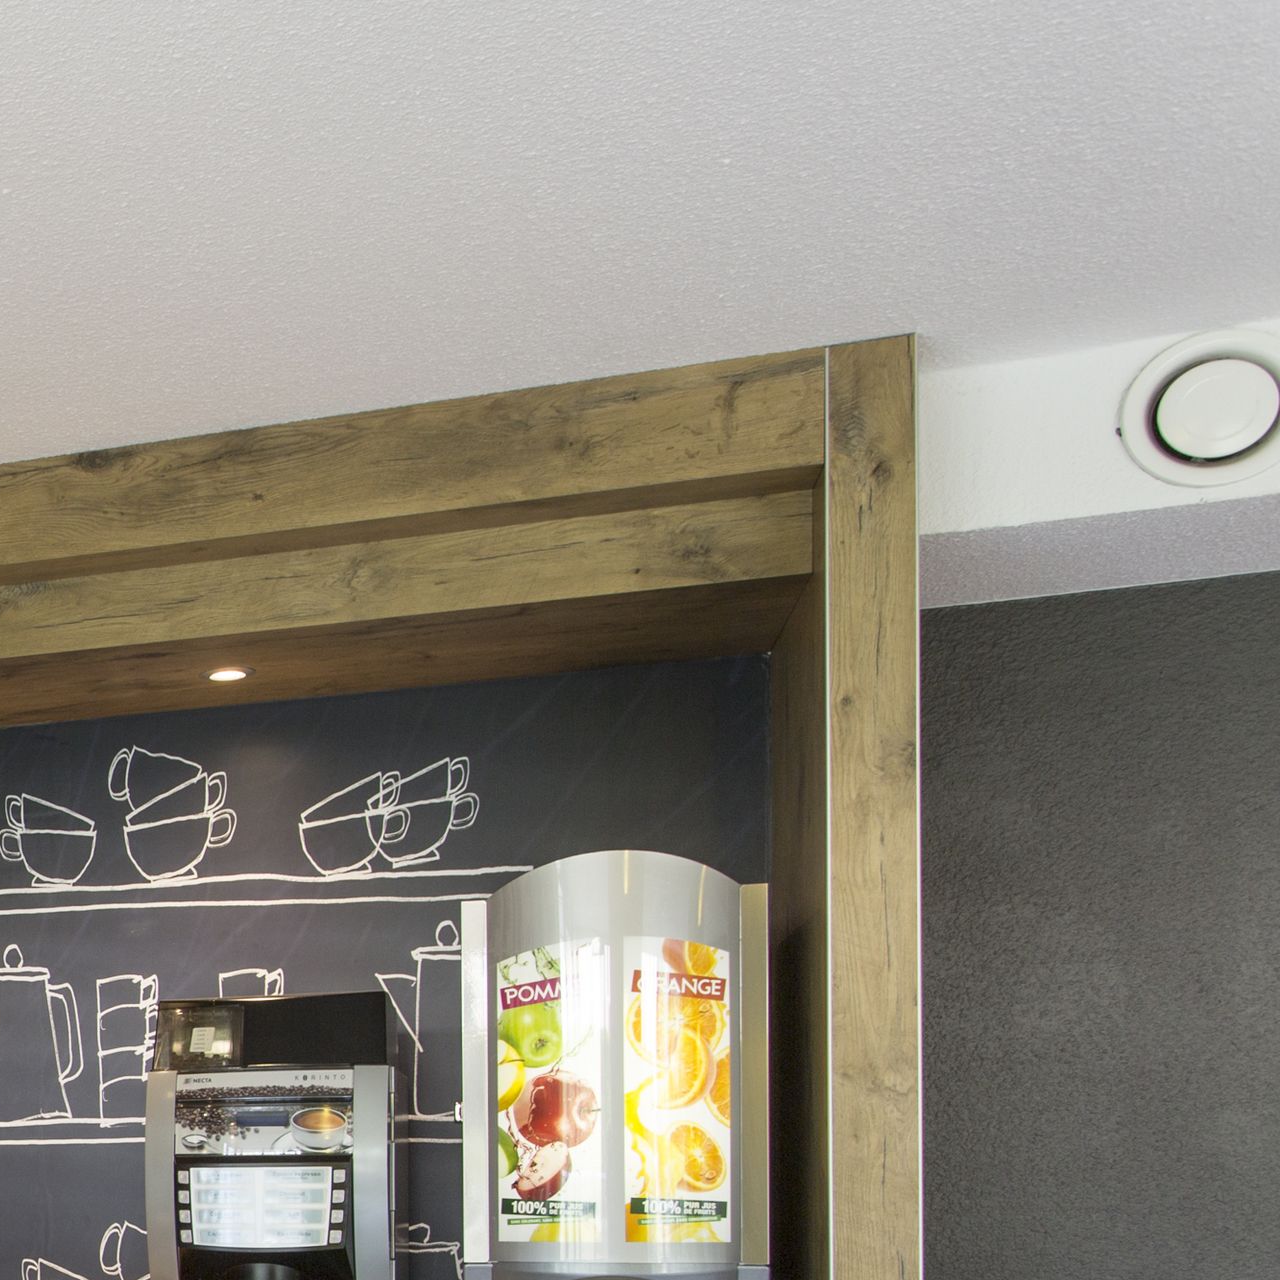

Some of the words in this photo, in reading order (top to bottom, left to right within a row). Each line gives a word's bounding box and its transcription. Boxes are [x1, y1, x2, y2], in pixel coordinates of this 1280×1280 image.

[511, 1200, 547, 1215] 100%
[641, 1199, 682, 1215] 100%
[683, 1201, 701, 1209] PUR
[701, 1202, 717, 1210] JUS
[683, 1208, 693, 1216] DE
[693, 1208, 717, 1217] FRUITS
